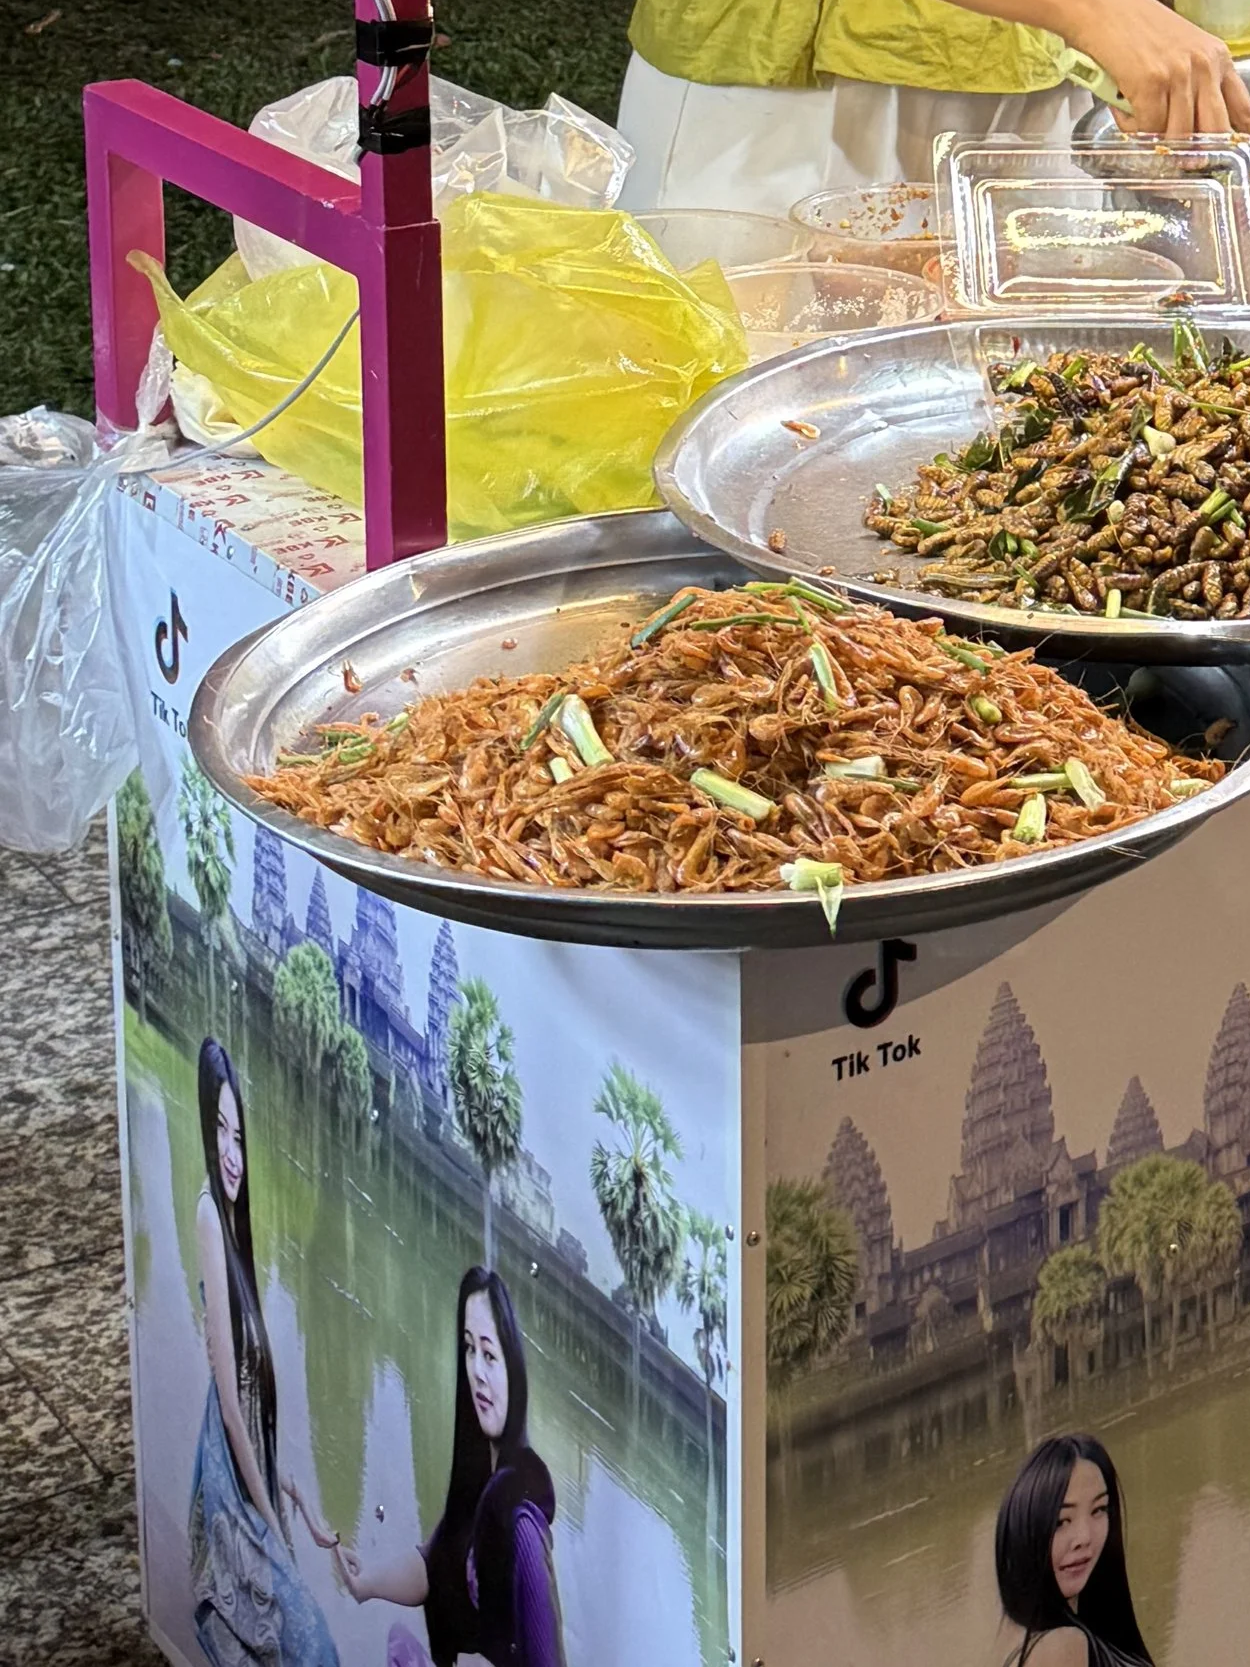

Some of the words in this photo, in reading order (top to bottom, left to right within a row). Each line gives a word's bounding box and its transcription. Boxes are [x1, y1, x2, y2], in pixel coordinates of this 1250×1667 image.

[272, 541, 314, 555] KBE
[151, 690, 170, 726] Tik
[171, 707, 187, 738] To
[832, 1050, 870, 1081] Tik
[877, 1034, 921, 1067] Tok
